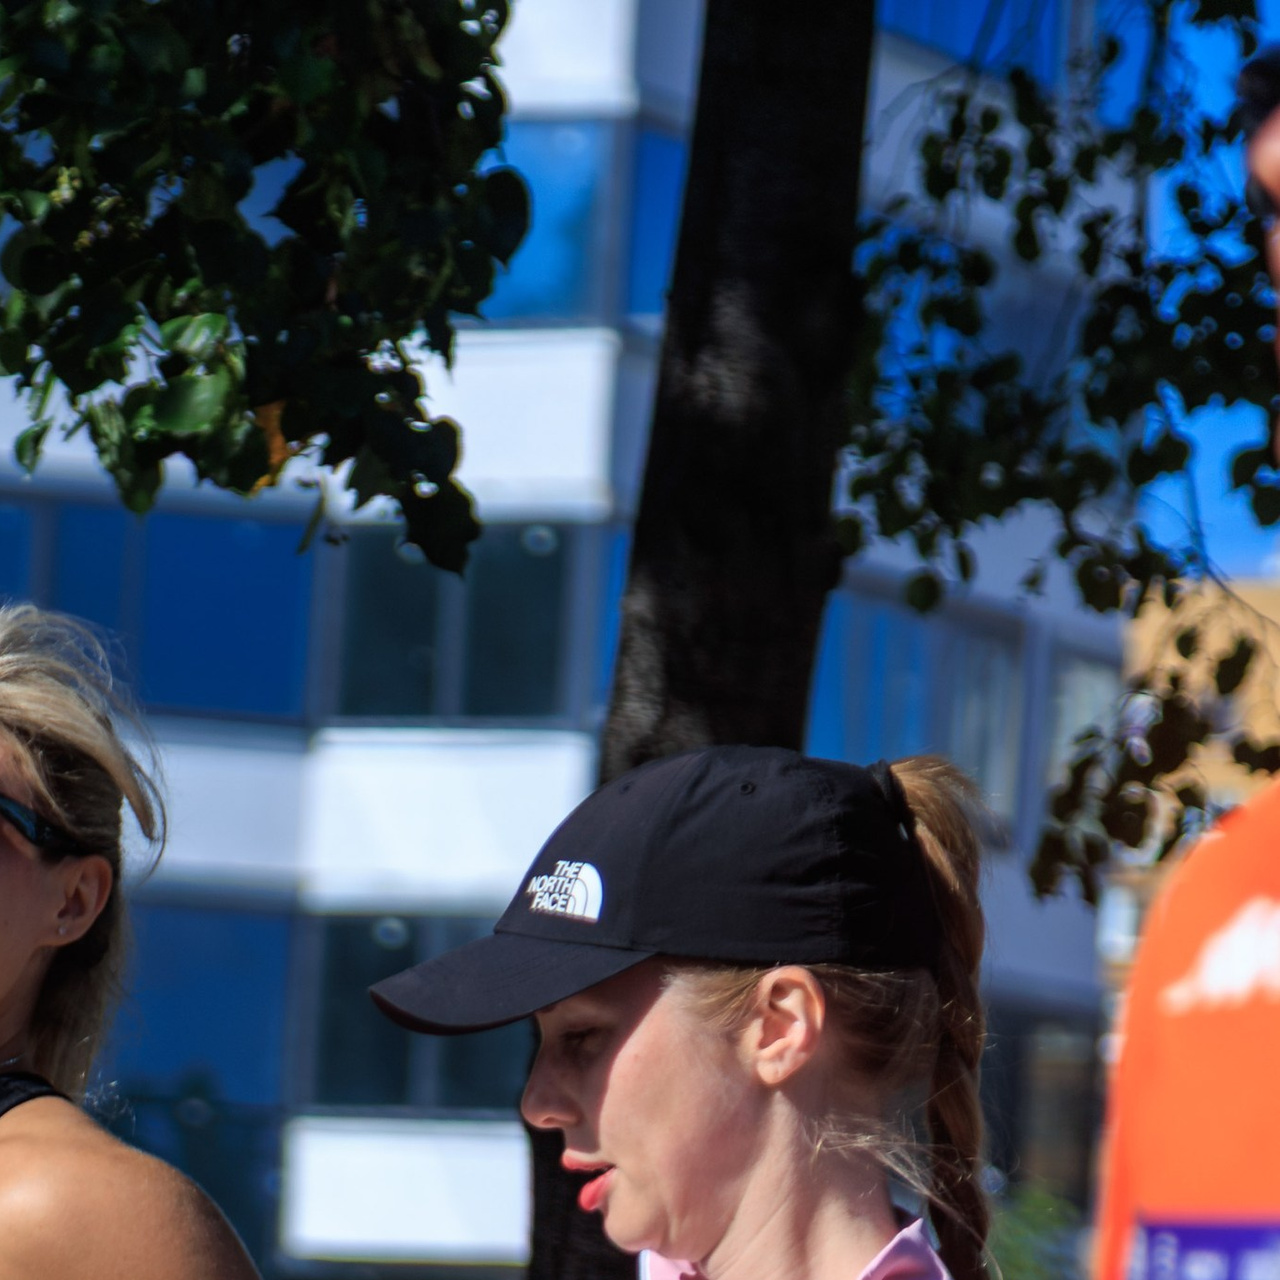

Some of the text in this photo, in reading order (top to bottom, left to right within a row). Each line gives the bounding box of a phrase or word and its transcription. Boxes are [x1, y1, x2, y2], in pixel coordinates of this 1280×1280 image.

[554, 860, 583, 878] THE
[526, 875, 576, 895] NORTH
[530, 892, 570, 913] FACE
